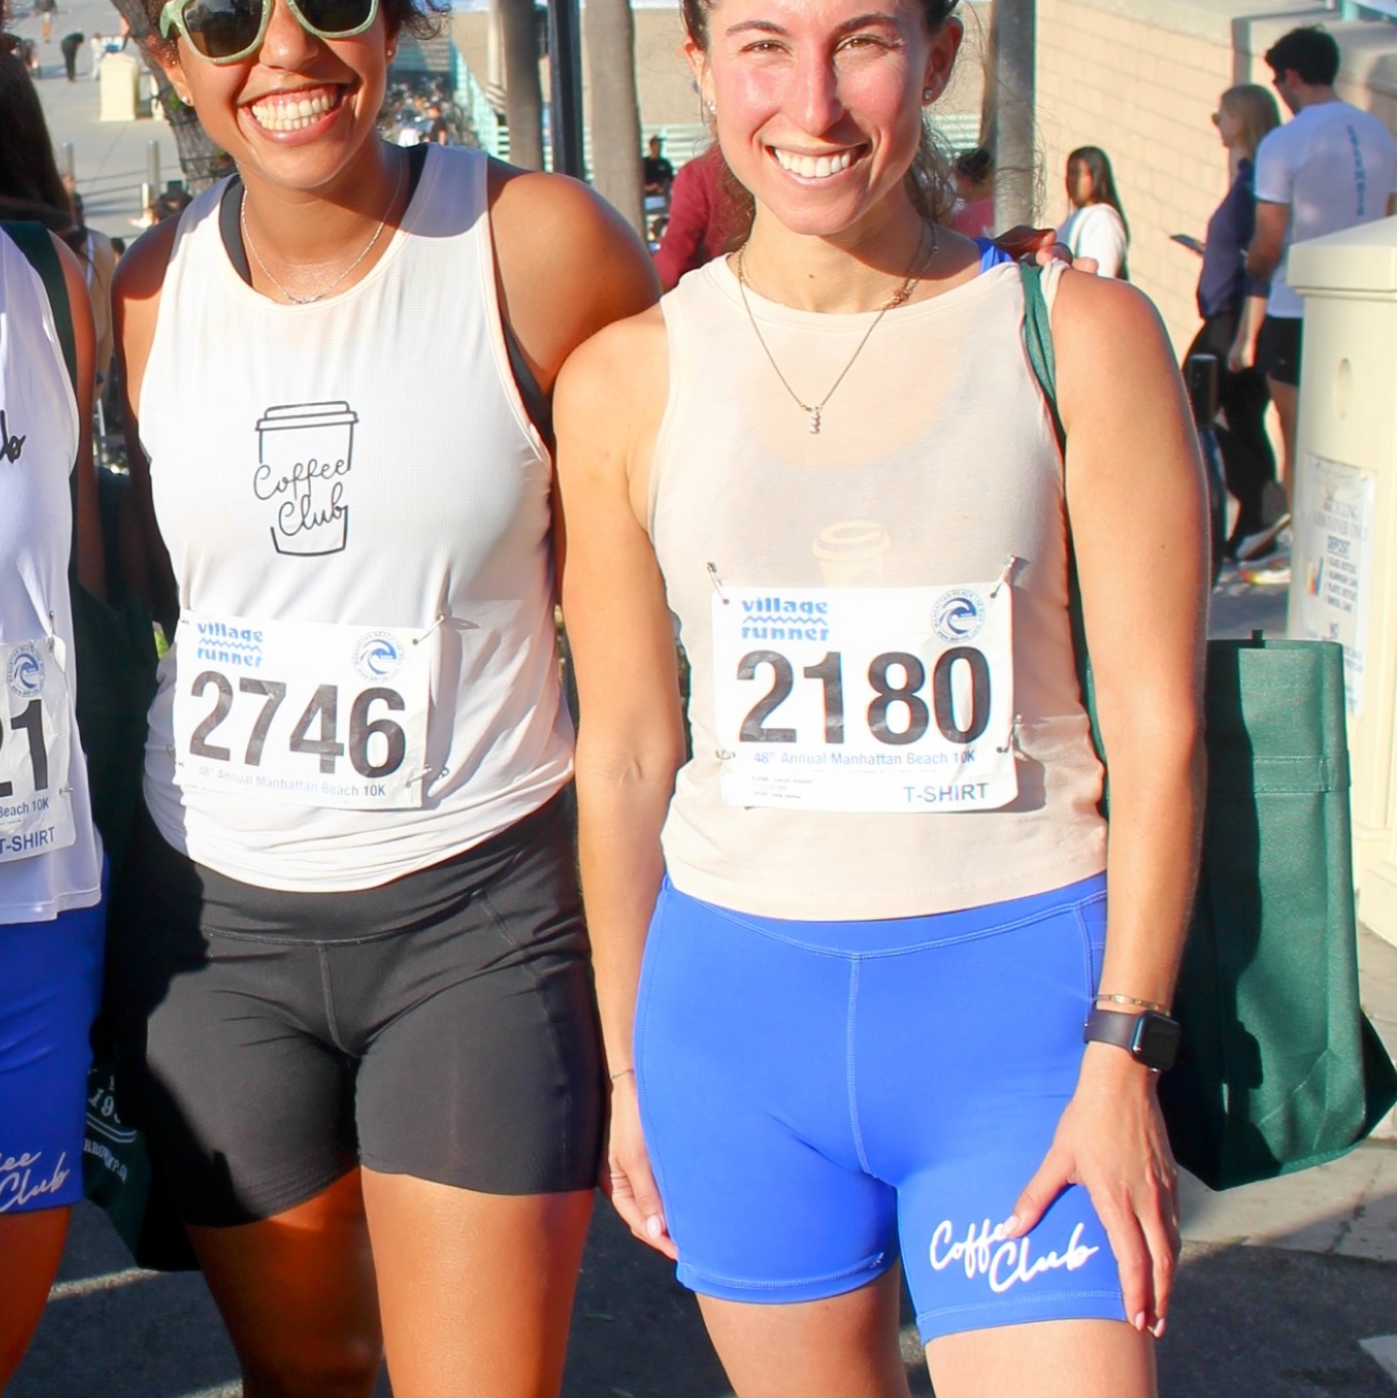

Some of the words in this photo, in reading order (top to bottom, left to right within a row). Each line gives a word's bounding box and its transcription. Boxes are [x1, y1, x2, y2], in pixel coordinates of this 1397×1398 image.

[254, 459, 348, 500] Coffee
[279, 482, 347, 536] Club
[741, 597, 828, 615] village
[197, 621, 263, 643] village
[741, 627, 829, 641] runner
[197, 646, 263, 668] runner
[736, 646, 991, 745] 2180
[189, 670, 406, 779] 2746
[780, 752, 827, 764] Annual
[831, 752, 902, 765] Manhattan
[907, 752, 948, 765] Beach
[953, 750, 976, 765] 10K
[217, 769, 253, 785] Annual
[255, 776, 319, 793] Manhattan
[321, 782, 359, 797] Beach
[363, 784, 386, 797] 10K
[903, 783, 989, 803] T-SHIRT
[32, 796, 50, 812] 10K
[989, 1222, 1100, 1292] Club
